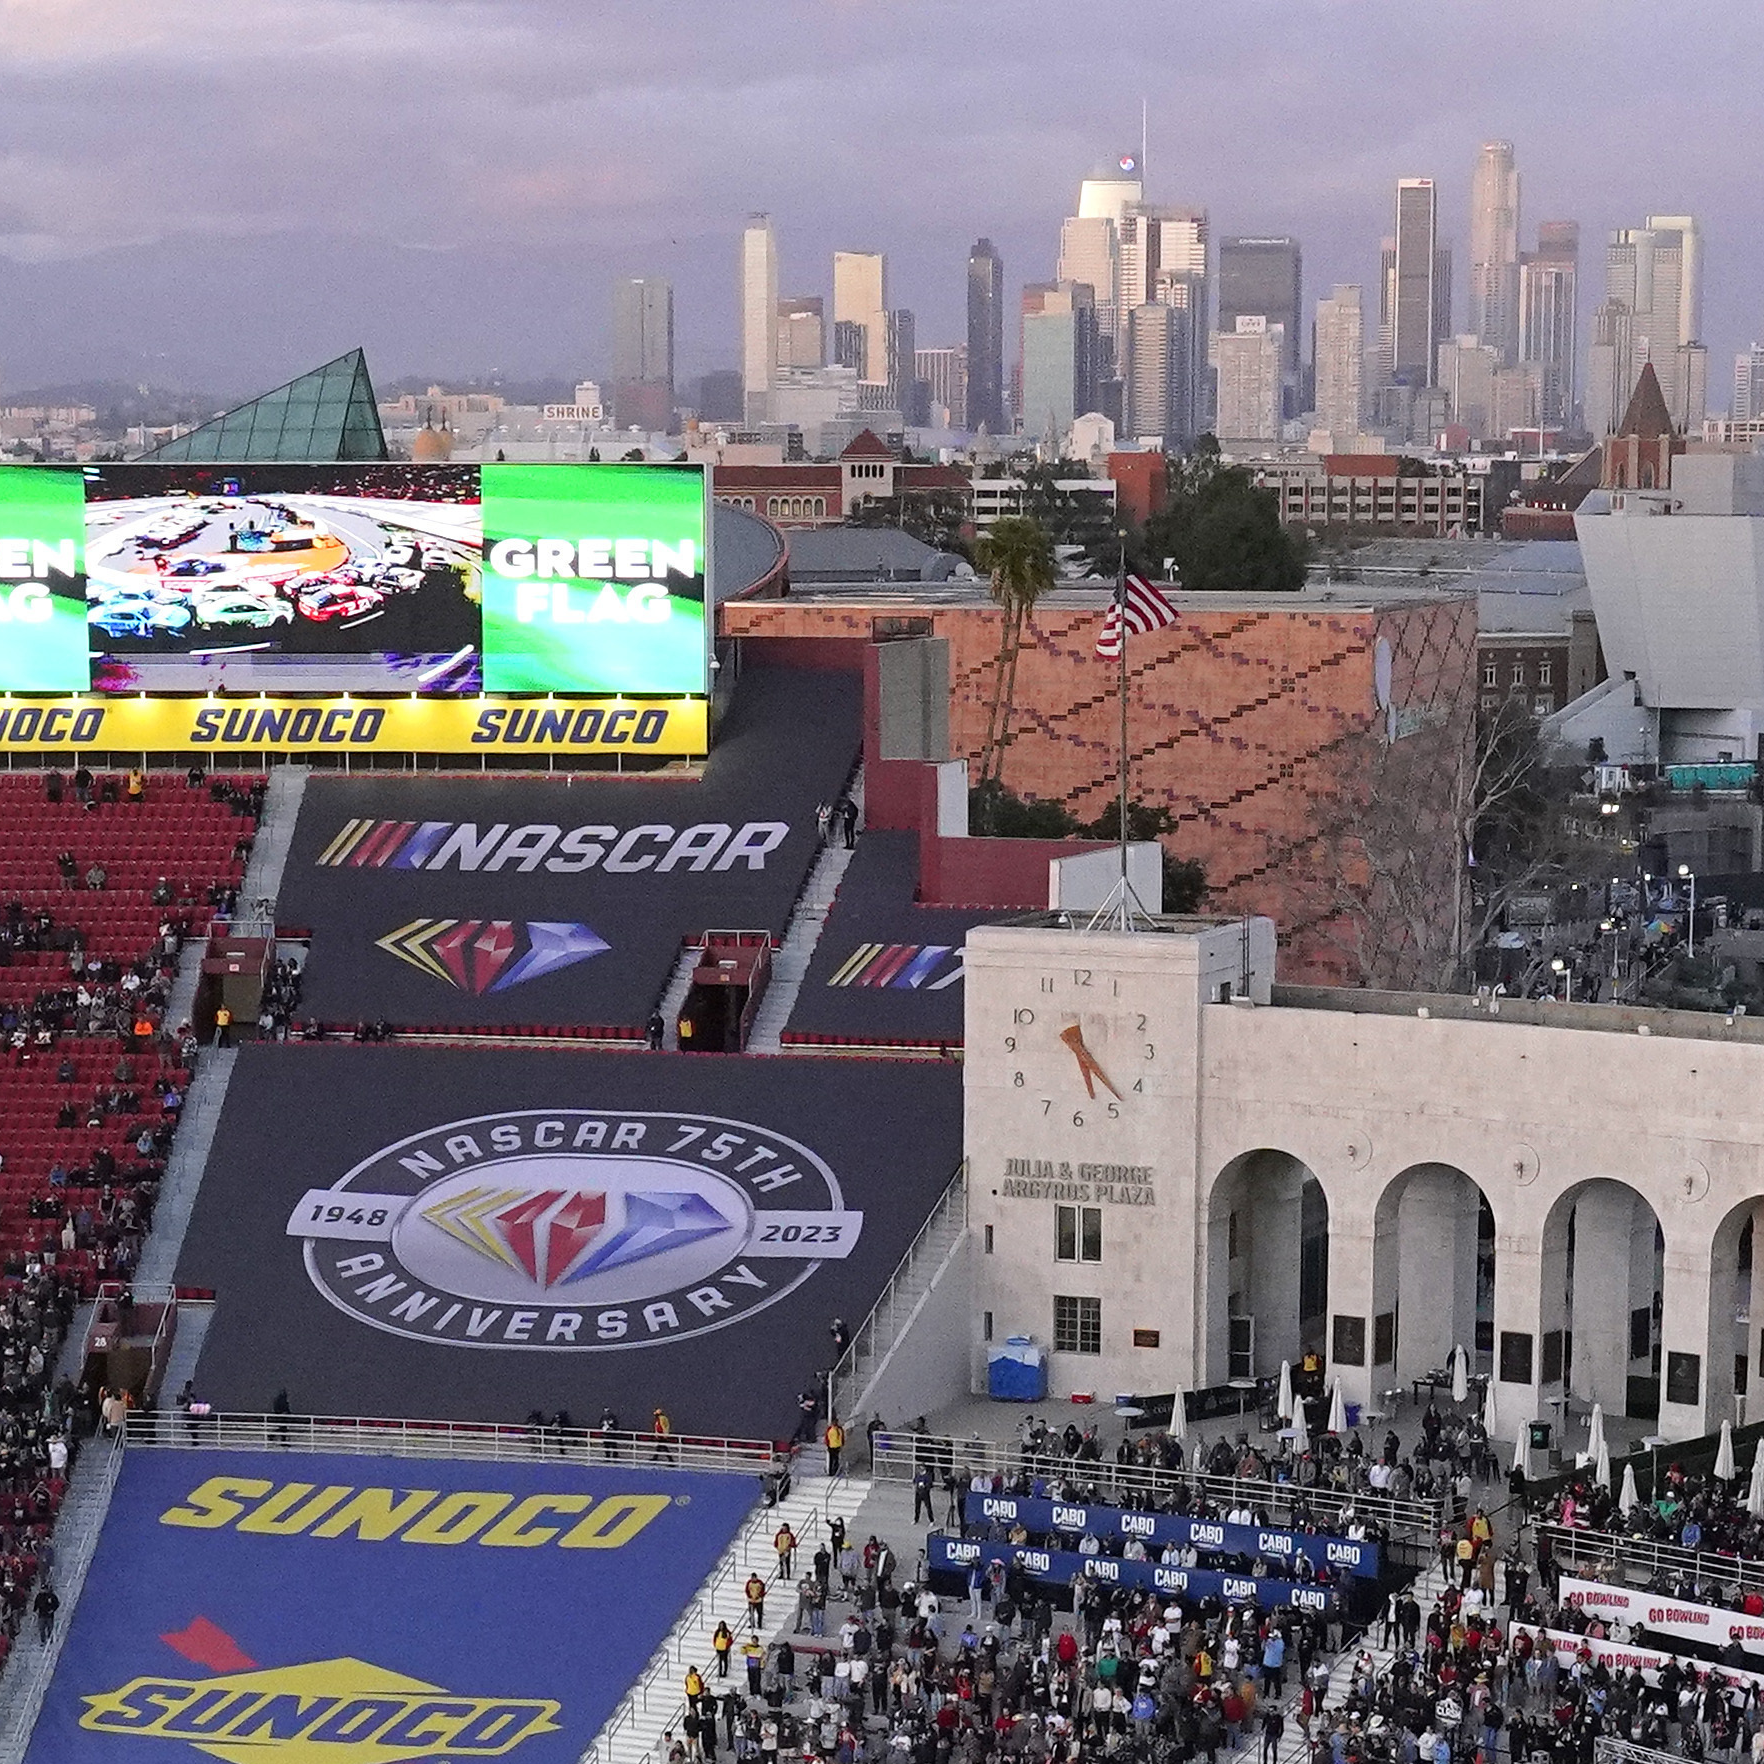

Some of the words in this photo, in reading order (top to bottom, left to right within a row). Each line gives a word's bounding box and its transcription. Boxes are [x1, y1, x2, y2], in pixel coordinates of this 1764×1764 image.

[489, 539, 694, 578] GREEN
[517, 583, 672, 623] FLAG
[190, 708, 386, 743] SUNOCO
[471, 708, 668, 743] SUNOCO
[426, 821, 790, 872] NASCAR
[1041, 978, 1054, 993] 11
[1073, 970, 1092, 987] 12
[1013, 1008, 1034, 1025] 10
[1137, 1014, 1146, 1031] 2
[1005, 1037, 1015, 1054] 9
[1145, 1043, 1154, 1060] 3
[1014, 1071, 1024, 1087] 8
[1133, 1078, 1143, 1094] 4
[1041, 1100, 1051, 1116] 7
[1073, 1110, 1084, 1127] 6
[1108, 1103, 1119, 1119] 5
[397, 1119, 647, 1180] NASCAR
[674, 1124, 805, 1192] 75TH
[1004, 1159, 1054, 1178] JULIA
[1059, 1162, 1073, 1180] &
[1078, 1163, 1154, 1185] GEORGE
[1094, 1184, 1155, 1206] PLAZA
[310, 1204, 389, 1227] 1948
[758, 1222, 841, 1244] 2023
[335, 1252, 771, 1341] ANNIVERSARY
[159, 1475, 671, 1549] SUNOCO
[983, 1498, 1017, 1519] CABO
[1052, 1507, 1087, 1529] CABO
[1121, 1515, 1155, 1537] CABO
[1190, 1524, 1224, 1545] CABO
[946, 1542, 981, 1561] CABO
[1259, 1533, 1292, 1555] CABO
[1327, 1543, 1361, 1565] CABO
[1085, 1560, 1119, 1582] CABO
[1154, 1569, 1188, 1590] CABO
[1223, 1578, 1257, 1600] CABO
[1291, 1589, 1326, 1610] CABO
[1586, 1593, 1629, 1608] BOWLING
[1649, 1608, 1664, 1623] GO
[1666, 1609, 1710, 1625] BOWLING
[1729, 1626, 1744, 1641] GO
[93, 1680, 530, 1752] SUNOCO
